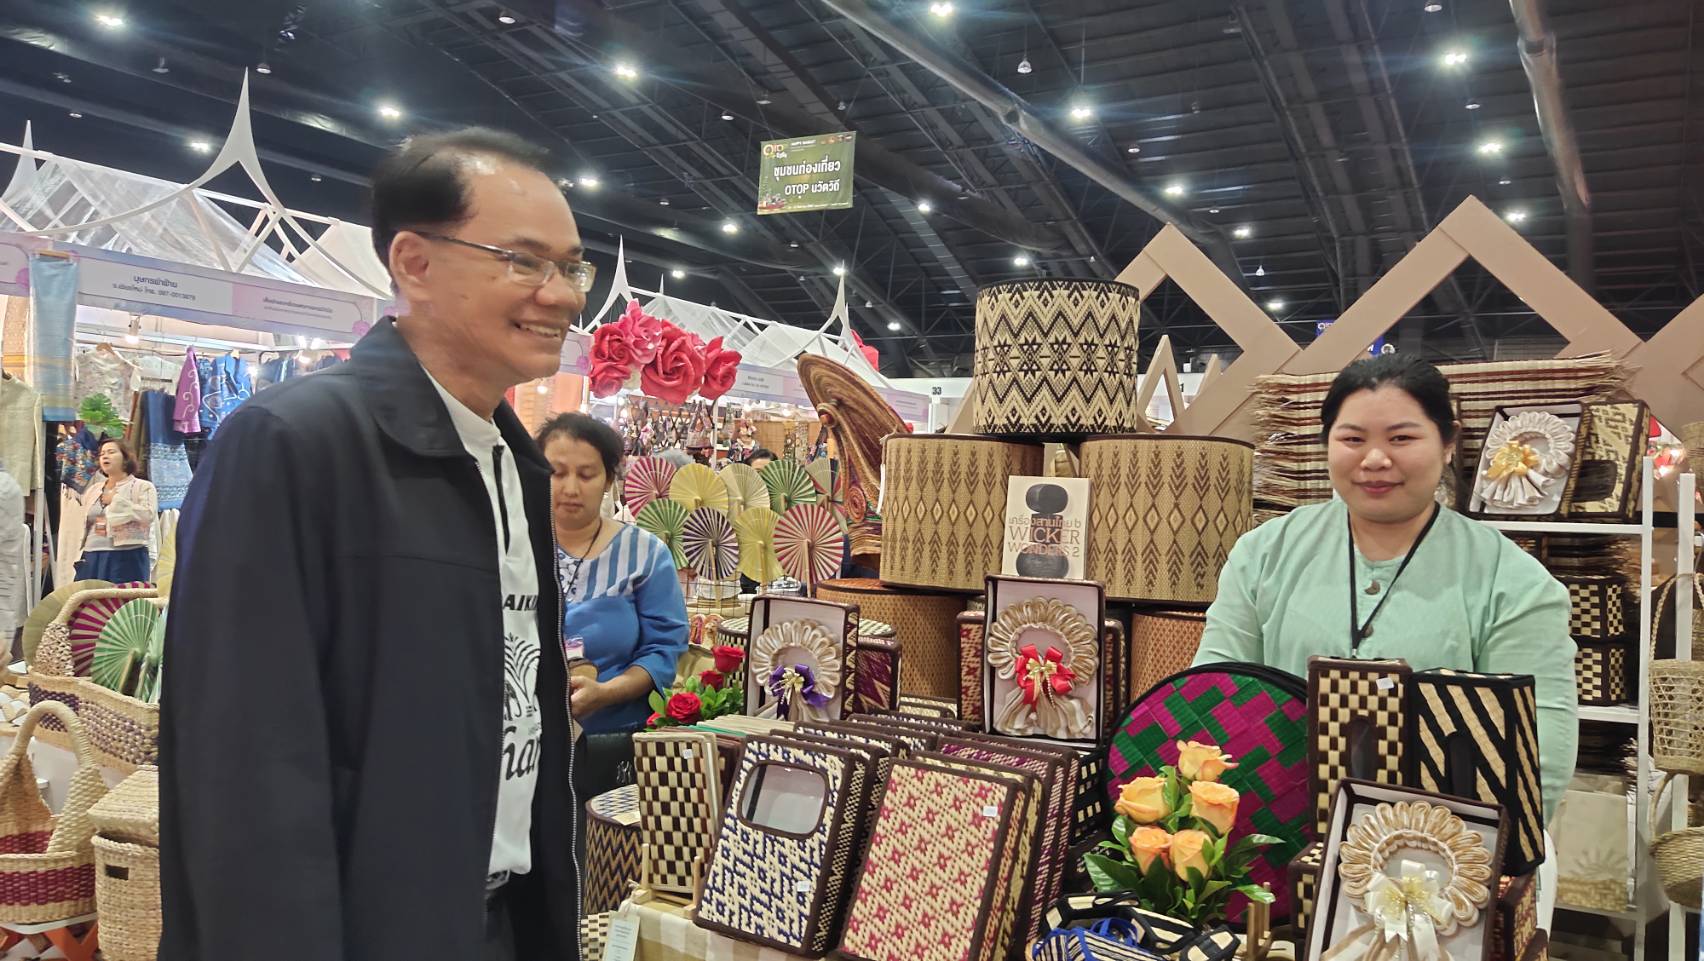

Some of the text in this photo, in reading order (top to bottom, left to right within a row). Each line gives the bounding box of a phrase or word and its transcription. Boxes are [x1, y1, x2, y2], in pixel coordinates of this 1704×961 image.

[774, 155, 841, 181] ชุมชนท่องเที่ยว
[784, 179, 840, 195] OTOP นวัตวิถี
[932, 386, 942, 395] 33
[1009, 526, 1080, 545] WICKER
[1008, 542, 1080, 557] WONDERS 2
